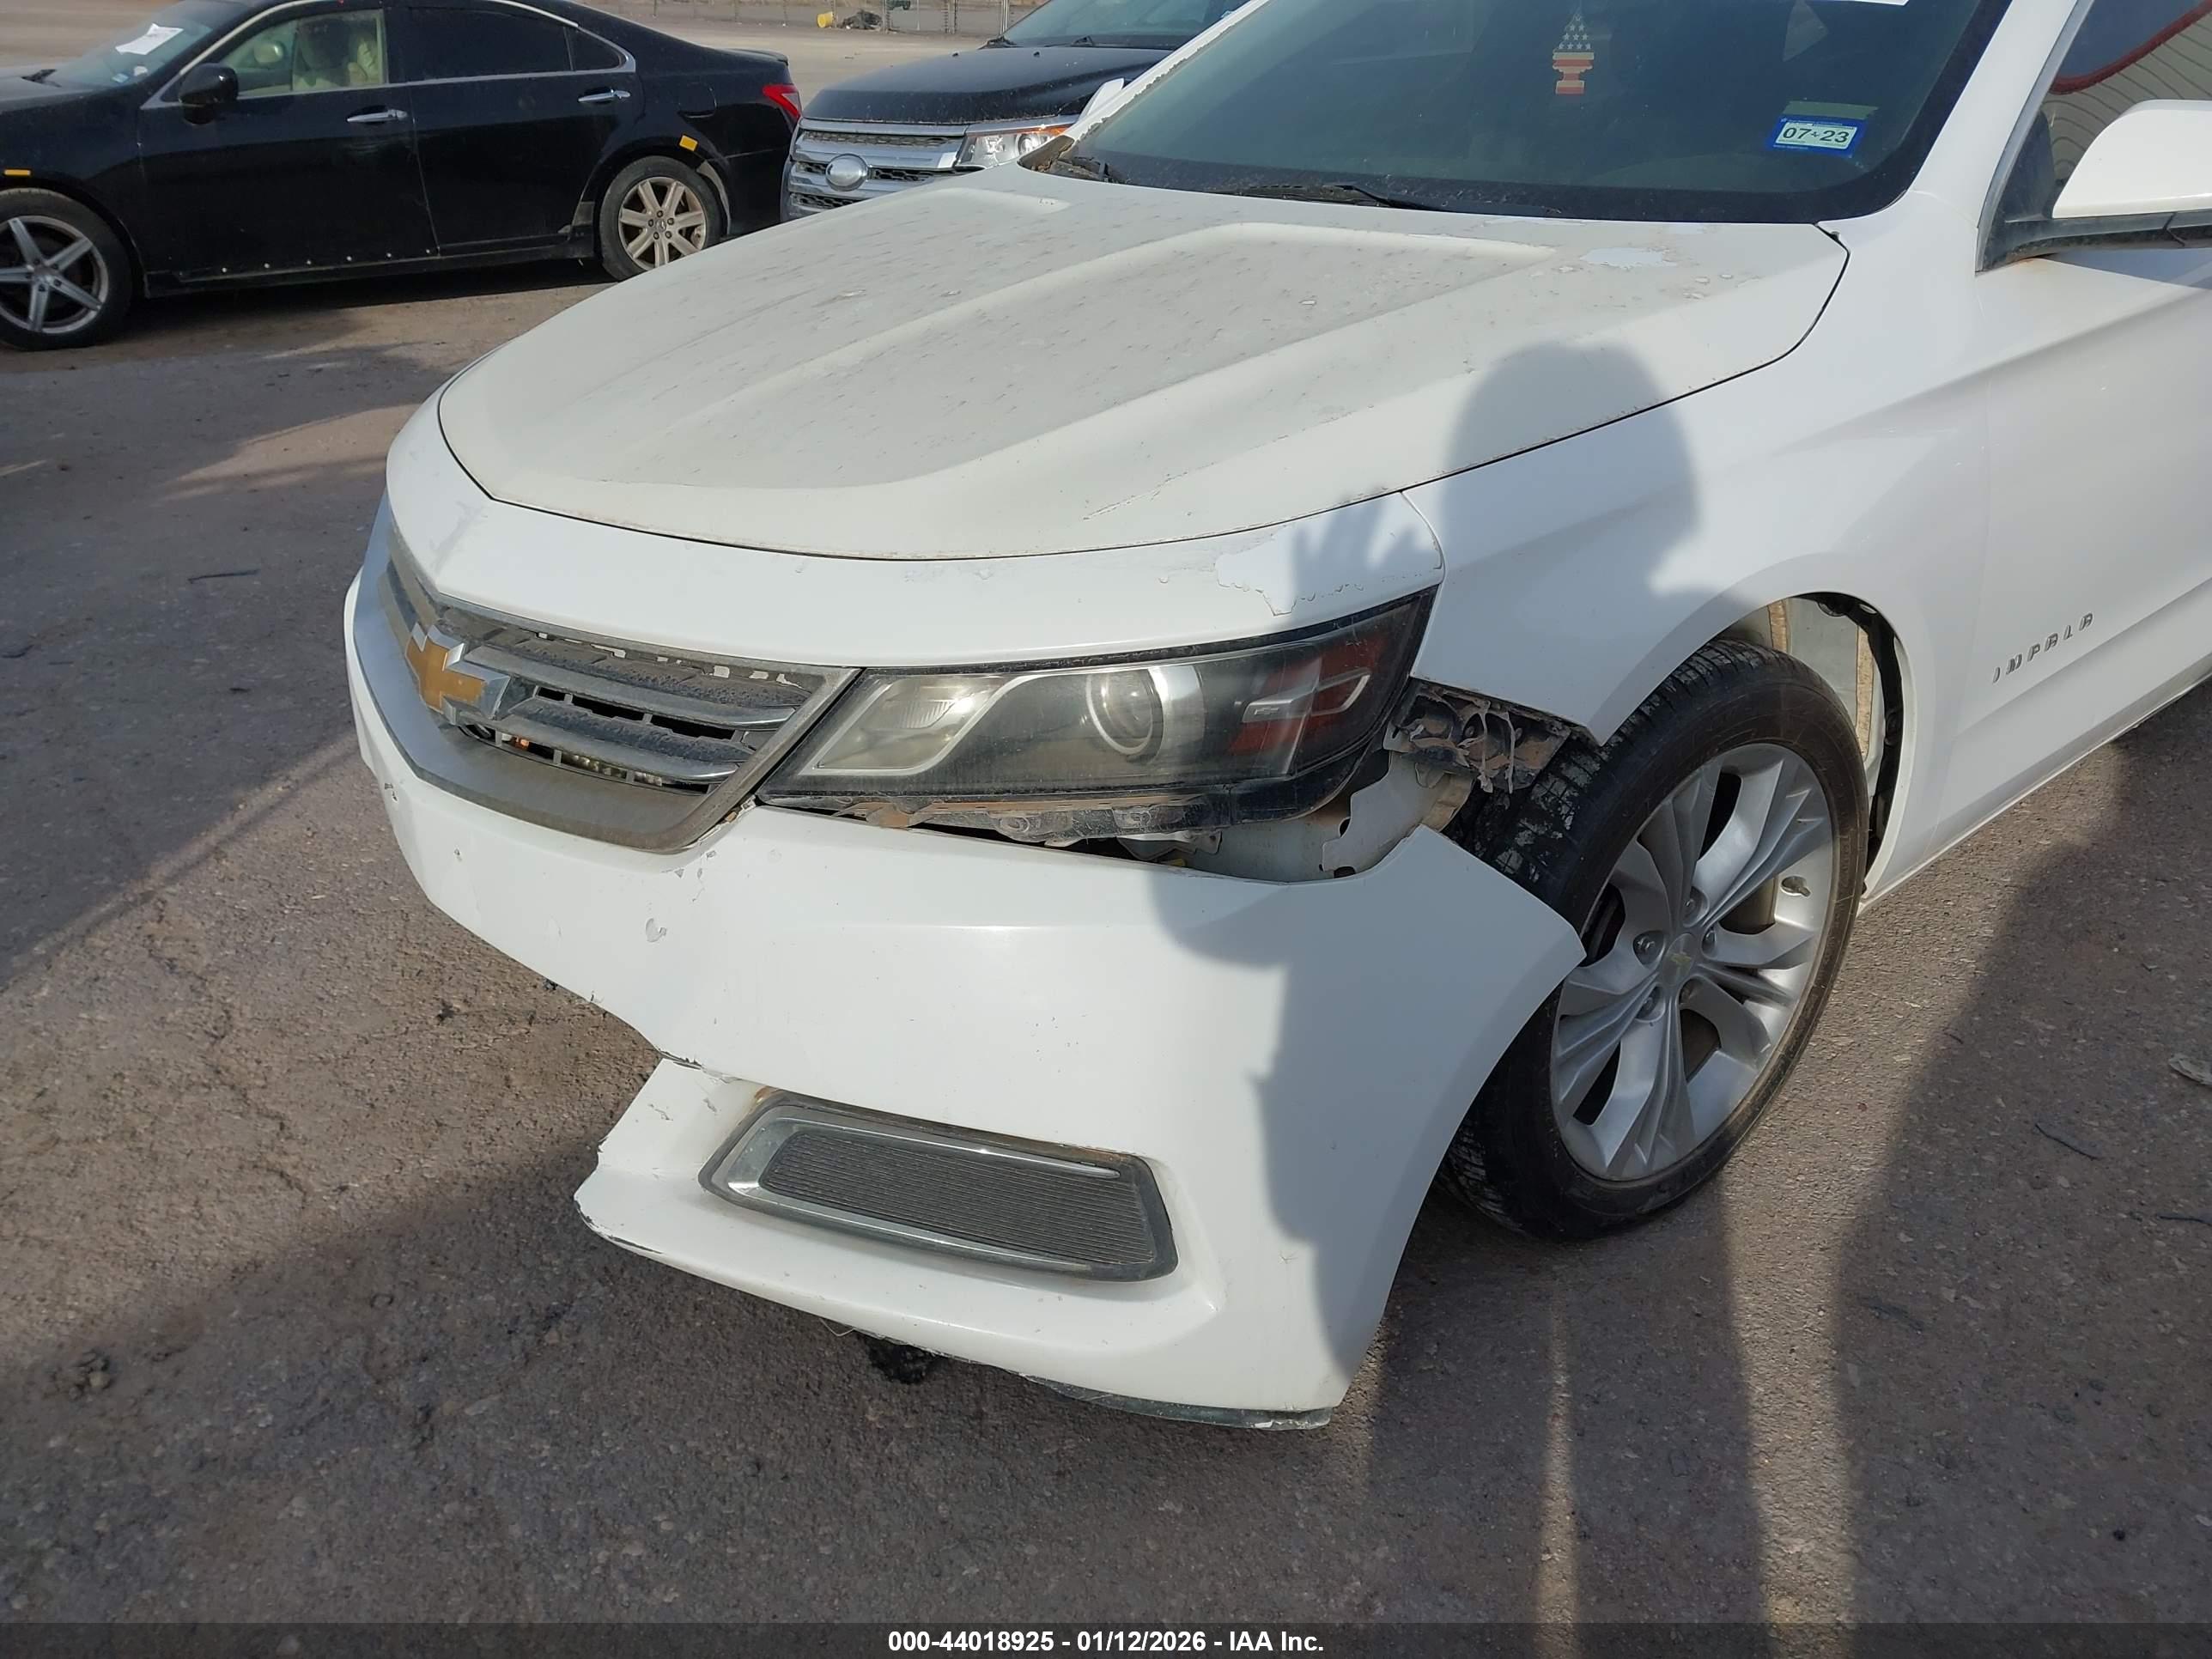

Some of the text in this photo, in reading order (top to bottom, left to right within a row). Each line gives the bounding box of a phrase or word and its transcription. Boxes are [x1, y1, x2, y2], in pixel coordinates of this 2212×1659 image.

[1783, 127, 1850, 143] 07 23
[1992, 612, 2094, 684] IMPALA
